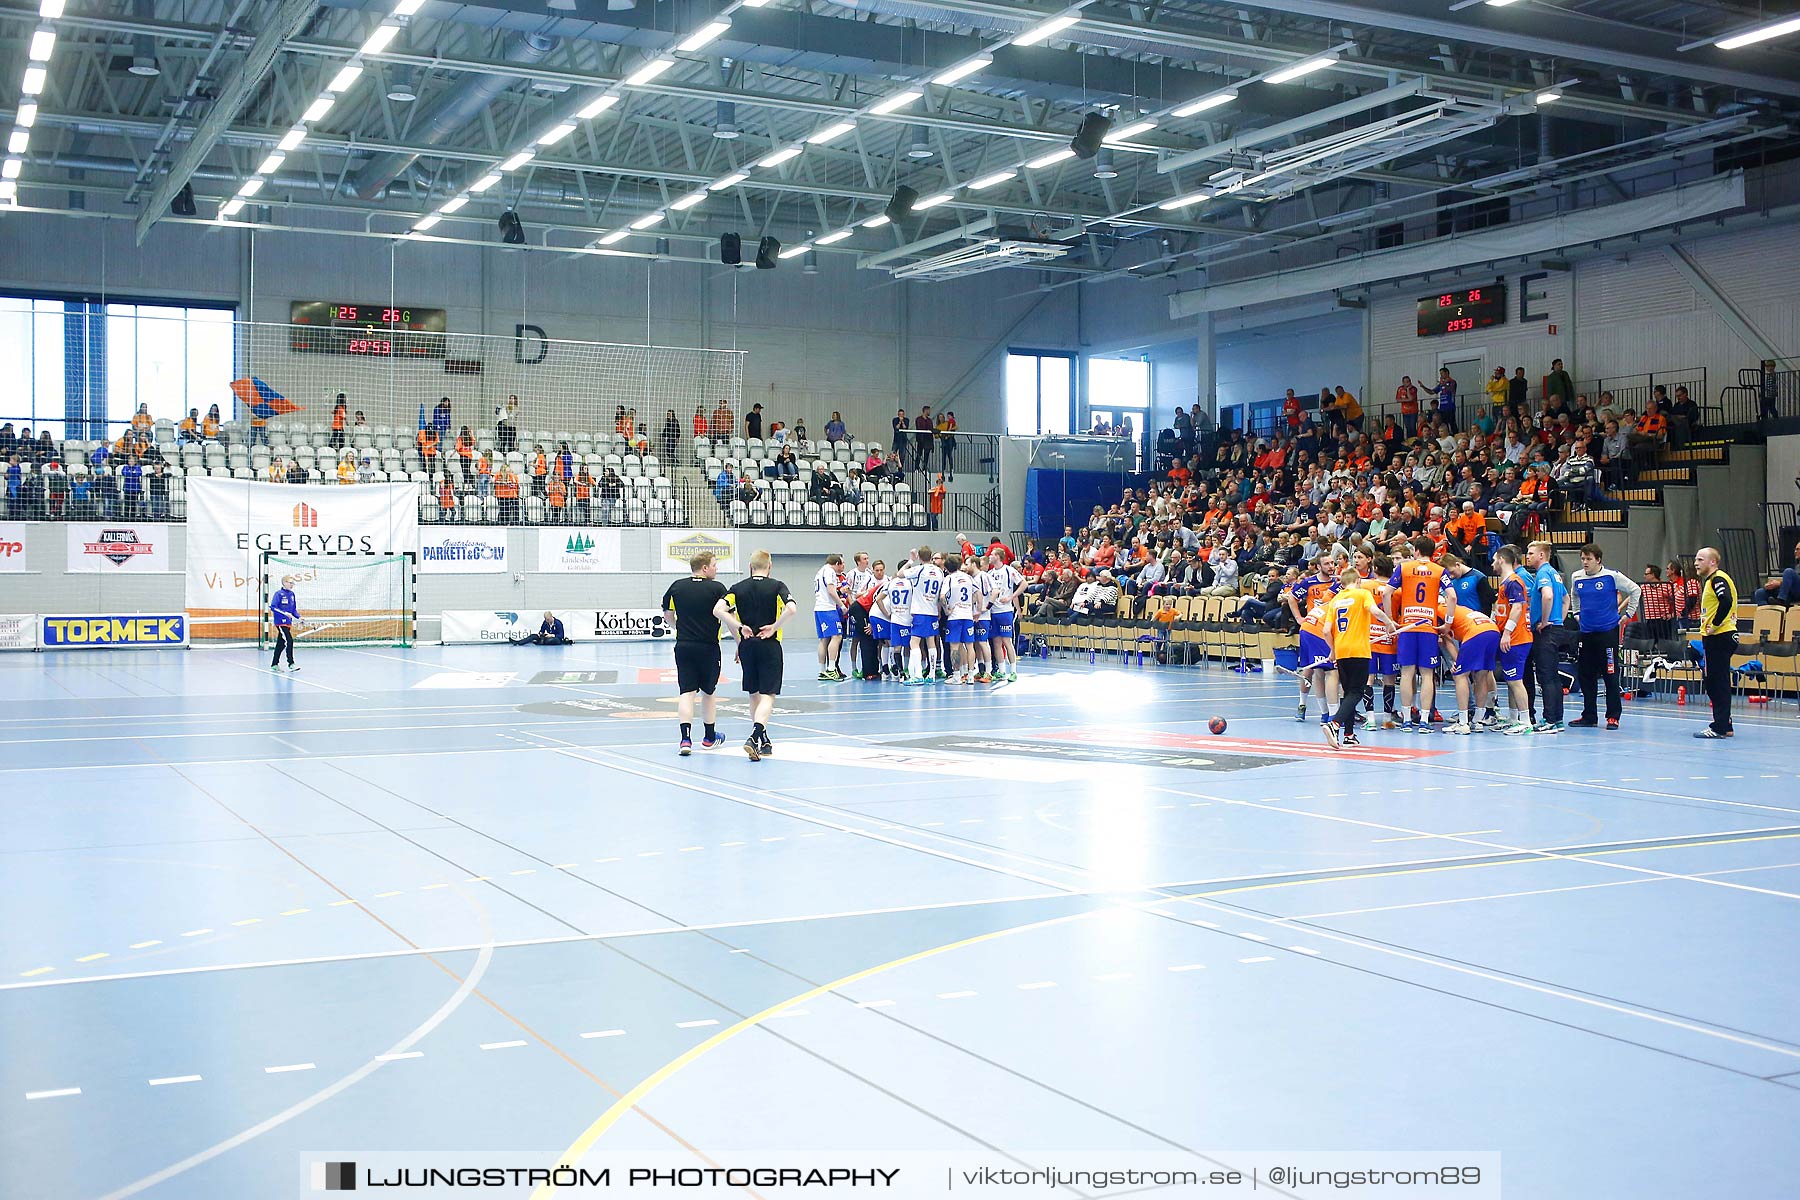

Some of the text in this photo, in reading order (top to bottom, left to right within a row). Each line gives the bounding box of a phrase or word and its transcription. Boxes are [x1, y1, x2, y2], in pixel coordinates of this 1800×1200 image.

[1440, 289, 1481, 307] 25 26
[329, 306, 338, 318] H
[339, 306, 357, 319] 25
[382, 309, 400, 322] 26
[402, 310, 410, 322] G
[1457, 307, 1463, 316] 2
[366, 324, 374, 334] 2
[515, 324, 548, 364] D
[237, 533, 372, 552] EGERYDS
[204, 572, 222, 589] Vi
[924, 579, 939, 594] 19
[891, 590, 909, 604] 87
[960, 587, 968, 601] 3
[1312, 588, 1320, 596] 15
[1415, 582, 1426, 603] 6
[48, 618, 180, 642] TORMEK
[595, 611, 670, 637] Körbergs
